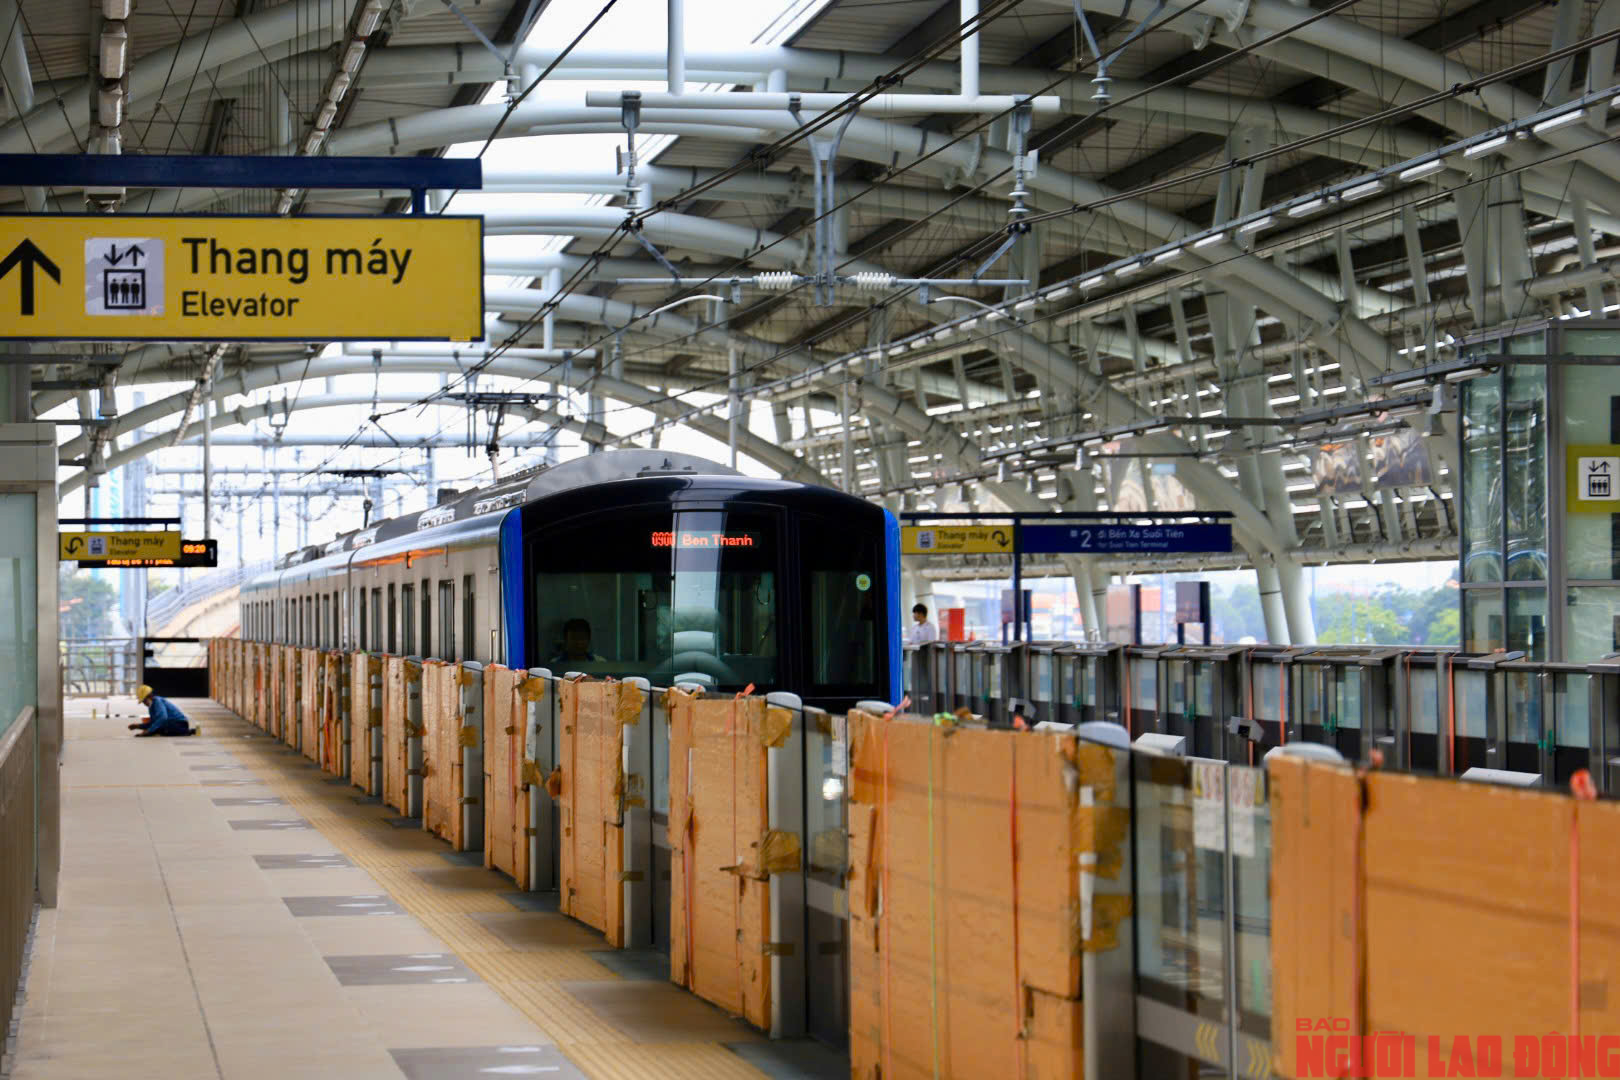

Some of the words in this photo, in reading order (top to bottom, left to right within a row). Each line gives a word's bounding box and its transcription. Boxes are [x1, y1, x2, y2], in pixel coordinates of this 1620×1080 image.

[181, 237, 309, 285] Thang
[325, 237, 413, 285] máy
[181, 291, 300, 317] Elevator
[682, 534, 708, 546] Ben
[711, 534, 753, 546] Thanh
[938, 530, 966, 542] Thang
[968, 529, 988, 542] máy
[1080, 529, 1092, 548] 2
[1129, 529, 1141, 539] Xe
[109, 535, 141, 547] Thang
[143, 535, 165, 547] máy
